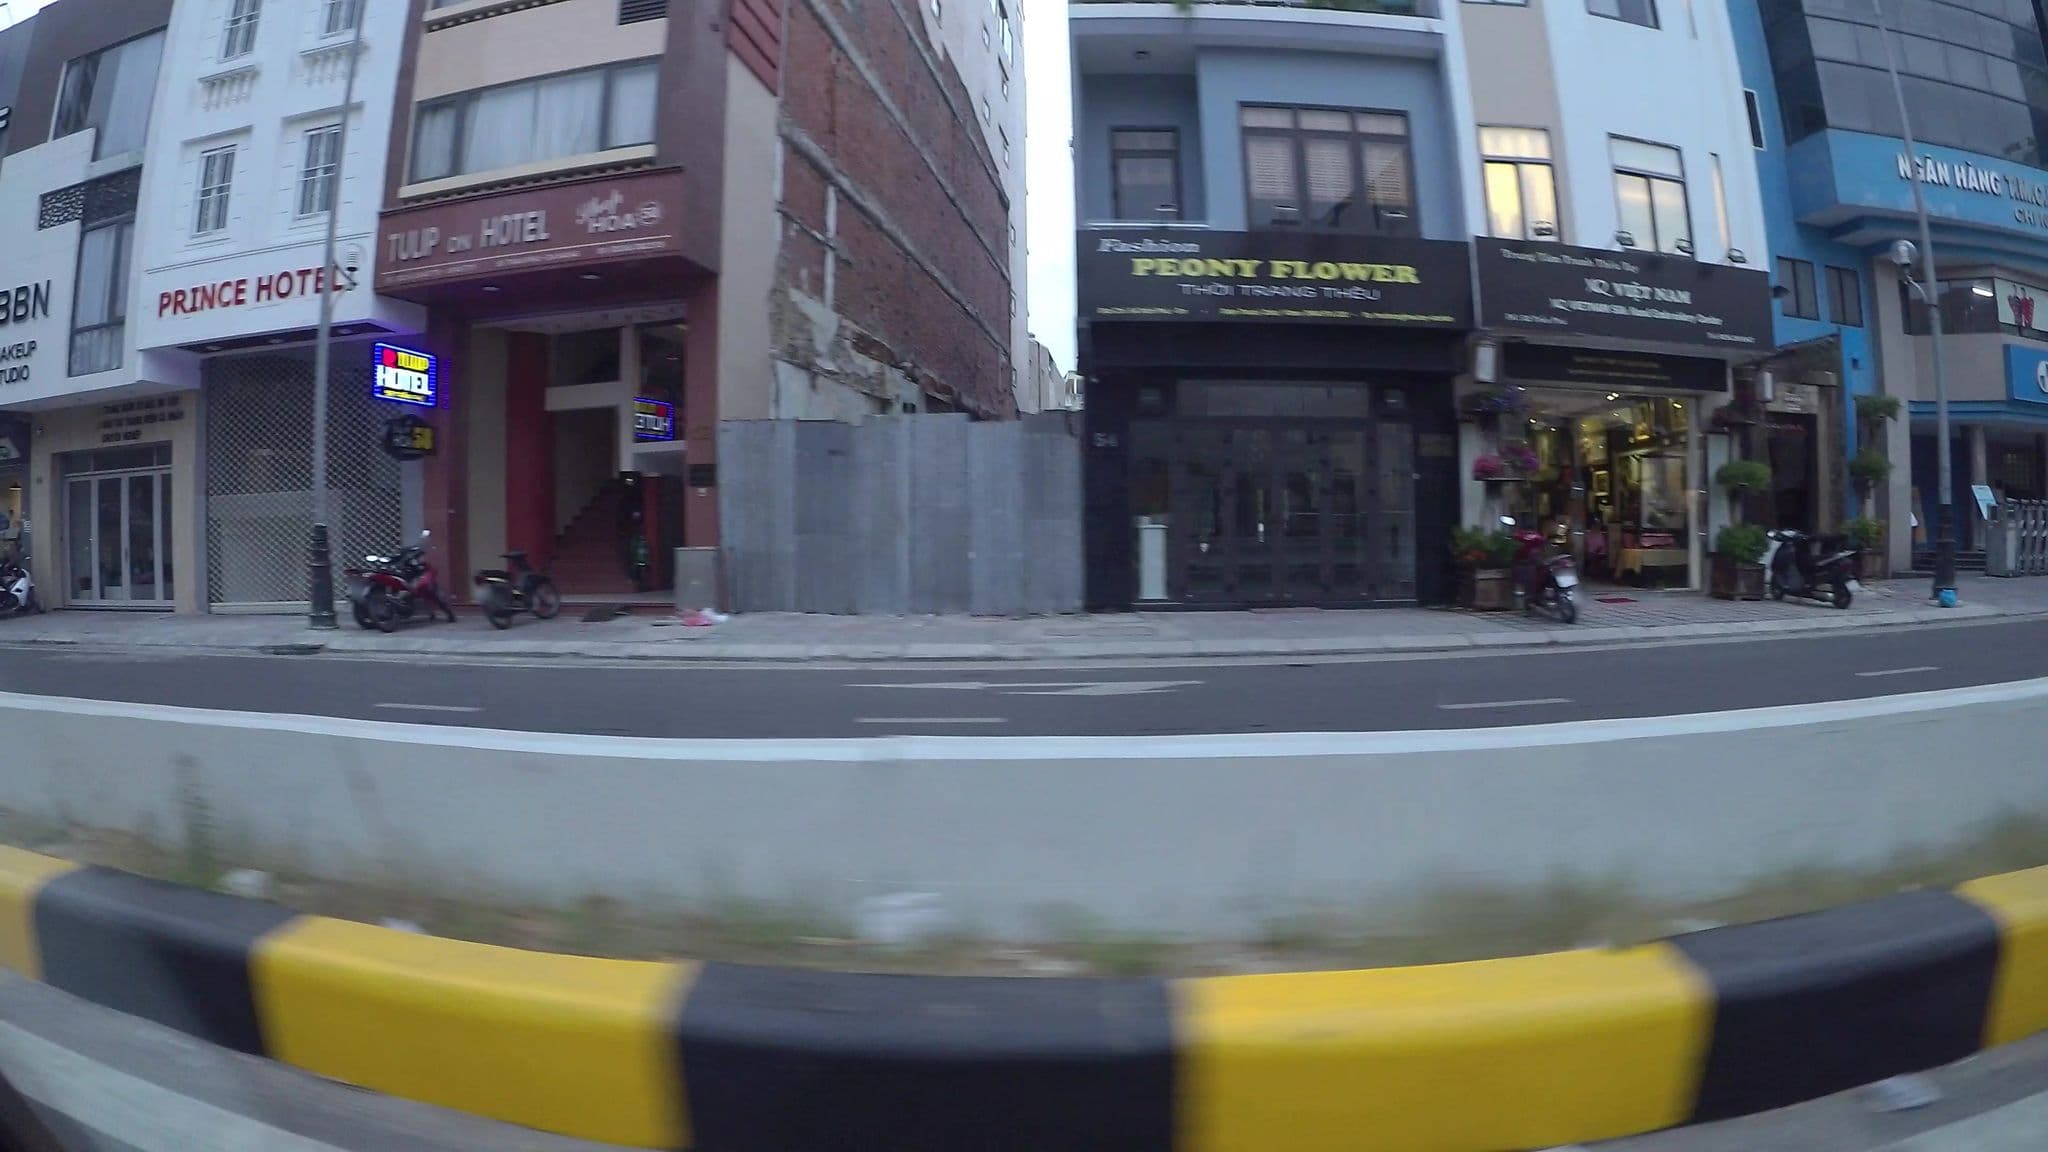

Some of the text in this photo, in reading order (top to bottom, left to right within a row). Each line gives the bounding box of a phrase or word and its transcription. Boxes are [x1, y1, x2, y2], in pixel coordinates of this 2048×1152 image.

[1953, 161, 2001, 197] HÀNG
[388, 226, 440, 263] TULIP
[479, 210, 550, 247] HOTEL
[1097, 238, 1200, 253] Fashion
[1131, 257, 1421, 284] PEONY FLOWER
[158, 278, 248, 317] PRINCE
[256, 264, 344, 302] HOTEL
[1236, 284, 1318, 299] TRANG
[1653, 286, 1692, 304] NAM
[376, 364, 433, 396] HOTEL
